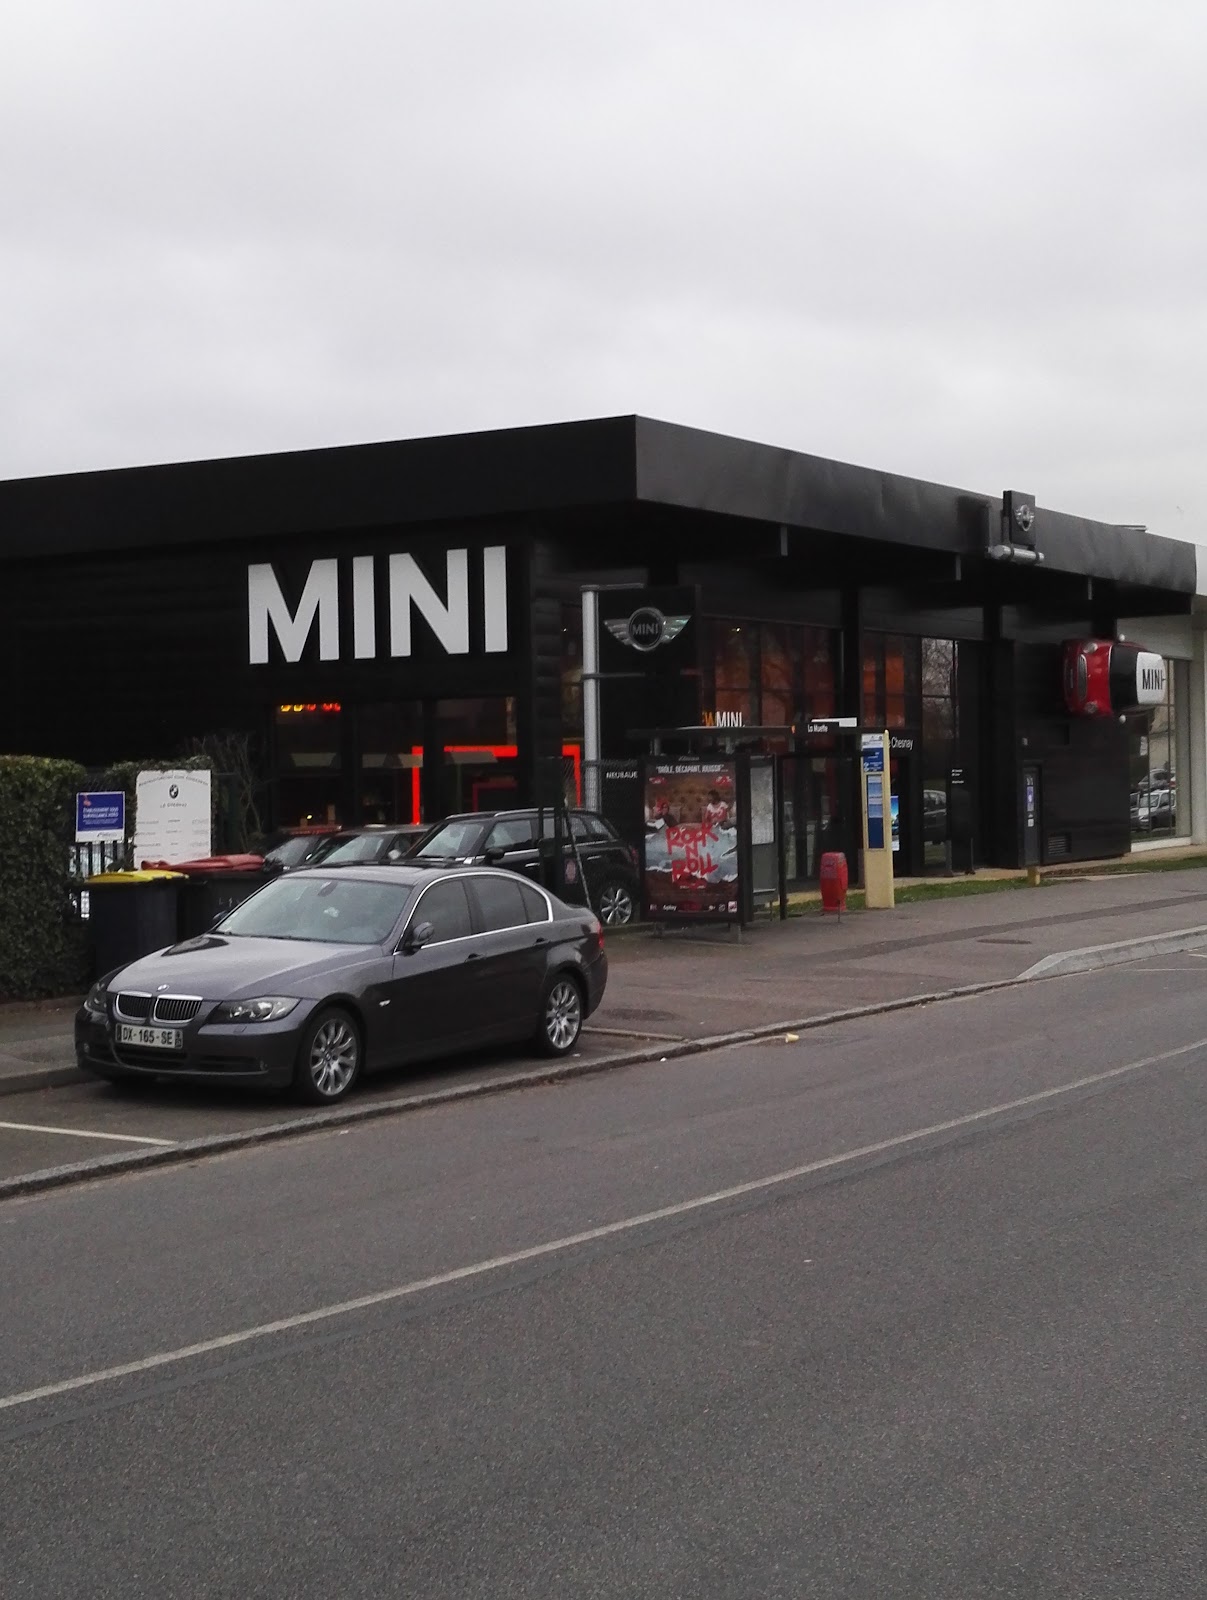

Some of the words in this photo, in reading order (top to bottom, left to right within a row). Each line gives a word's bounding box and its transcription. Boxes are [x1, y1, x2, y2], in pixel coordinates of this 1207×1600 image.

[248, 545, 509, 665] MINI
[632, 622, 658, 635] MINI
[1142, 668, 1163, 690] MINI
[891, 736, 914, 751] Chesnay
[665, 819, 719, 855] ROCK
[671, 853, 718, 882] ROLL
